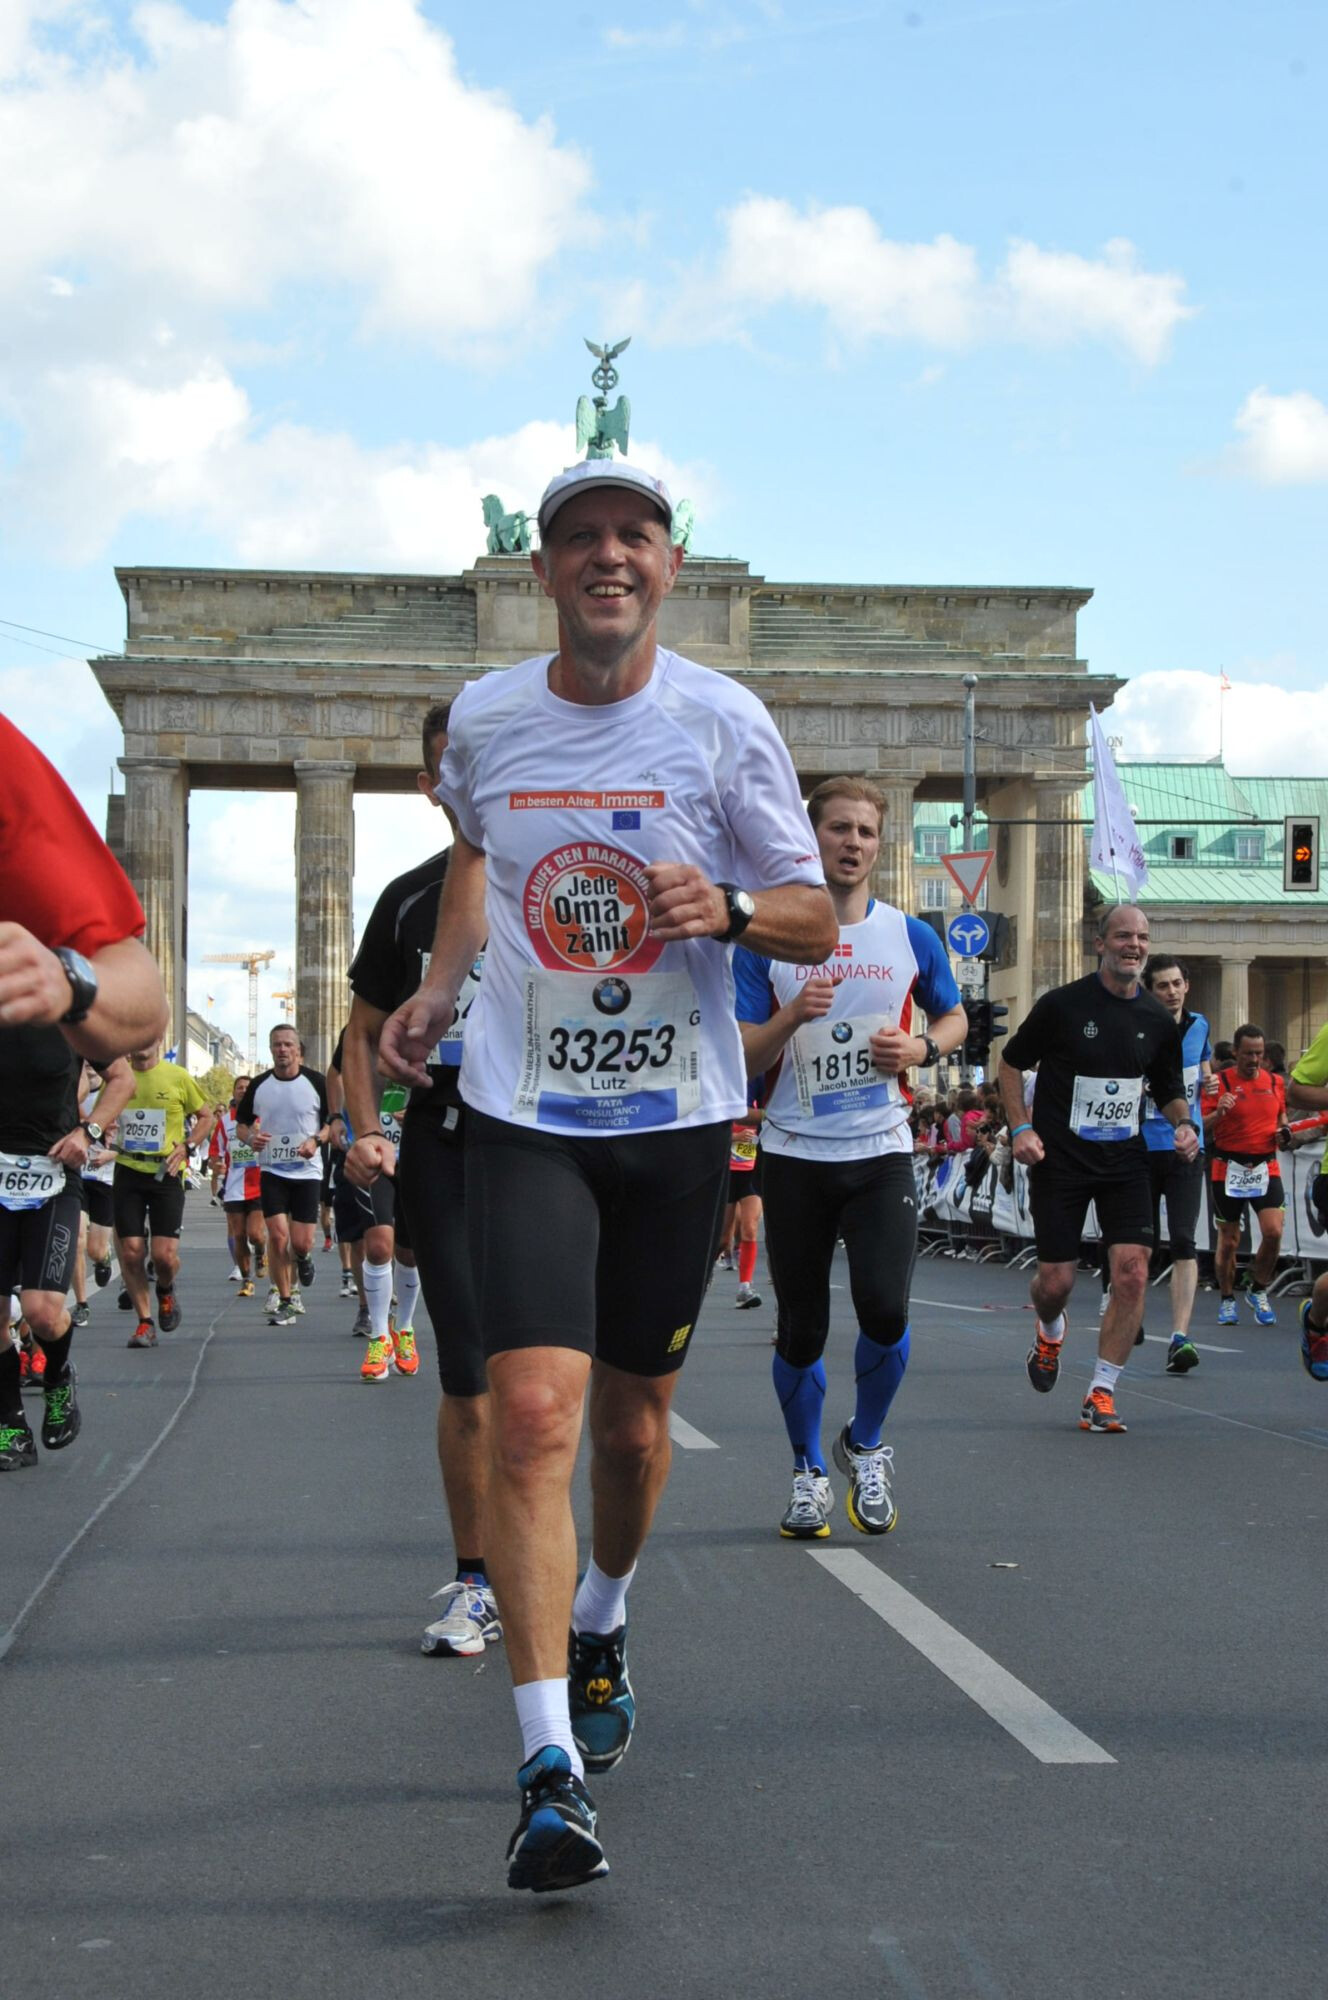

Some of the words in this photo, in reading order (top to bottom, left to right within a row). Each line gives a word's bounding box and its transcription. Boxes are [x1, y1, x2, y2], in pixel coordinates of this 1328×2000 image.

[513, 796, 526, 808] Im
[527, 795, 565, 808] besten
[566, 795, 599, 808] Alter.
[601, 792, 660, 807] Immer.
[553, 846, 584, 869] DEN
[586, 845, 652, 896] MARATHO
[528, 861, 557, 905] LAUFE
[567, 875, 618, 897] Jede
[527, 905, 542, 930] ICH
[553, 897, 621, 925] Oma
[566, 926, 630, 954] zählt
[795, 963, 893, 982] DANMARK
[526, 981, 535, 1072] BERLIN-MARATHON
[547, 1024, 676, 1074] 33253
[812, 1048, 877, 1083] 1815
[590, 1076, 627, 1091] Lutz
[819, 1081, 848, 1093] Jacob
[575, 1105, 641, 1118] CONSULTANCY
[596, 1098, 624, 1108] TATA
[1085, 1100, 1133, 1121] 14369
[125, 1123, 159, 1137] 20576
[587, 1116, 630, 1127] SERVICES
